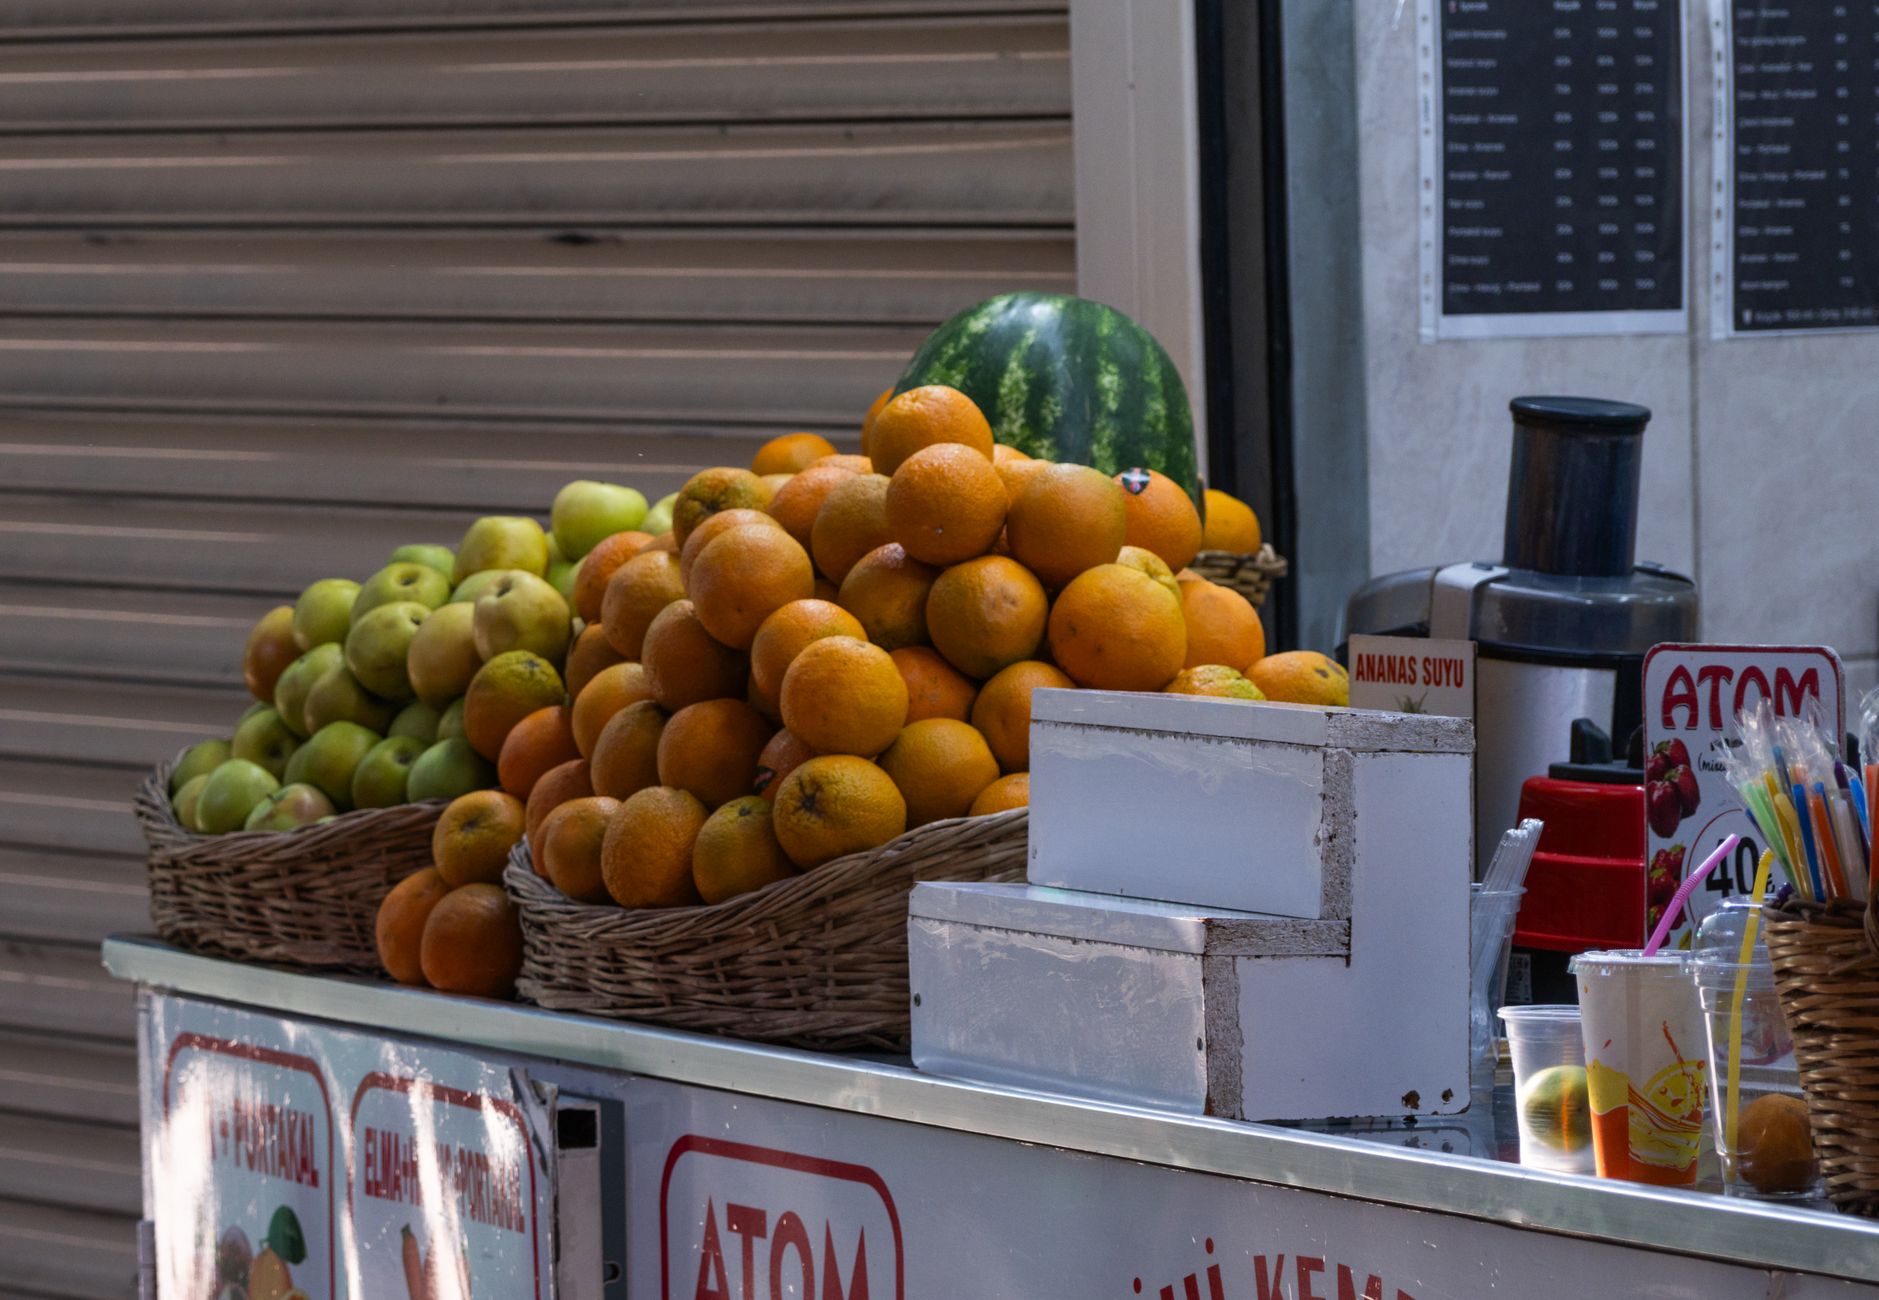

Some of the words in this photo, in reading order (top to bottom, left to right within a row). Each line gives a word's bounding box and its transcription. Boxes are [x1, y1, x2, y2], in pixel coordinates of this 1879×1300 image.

[1356, 653, 1417, 685] ANANAS
[1423, 656, 1464, 688] SUYU
[1661, 664, 1821, 731] ATOM
[234, 1097, 319, 1188] PORTAKAL
[694, 1194, 869, 1300] ATOM
